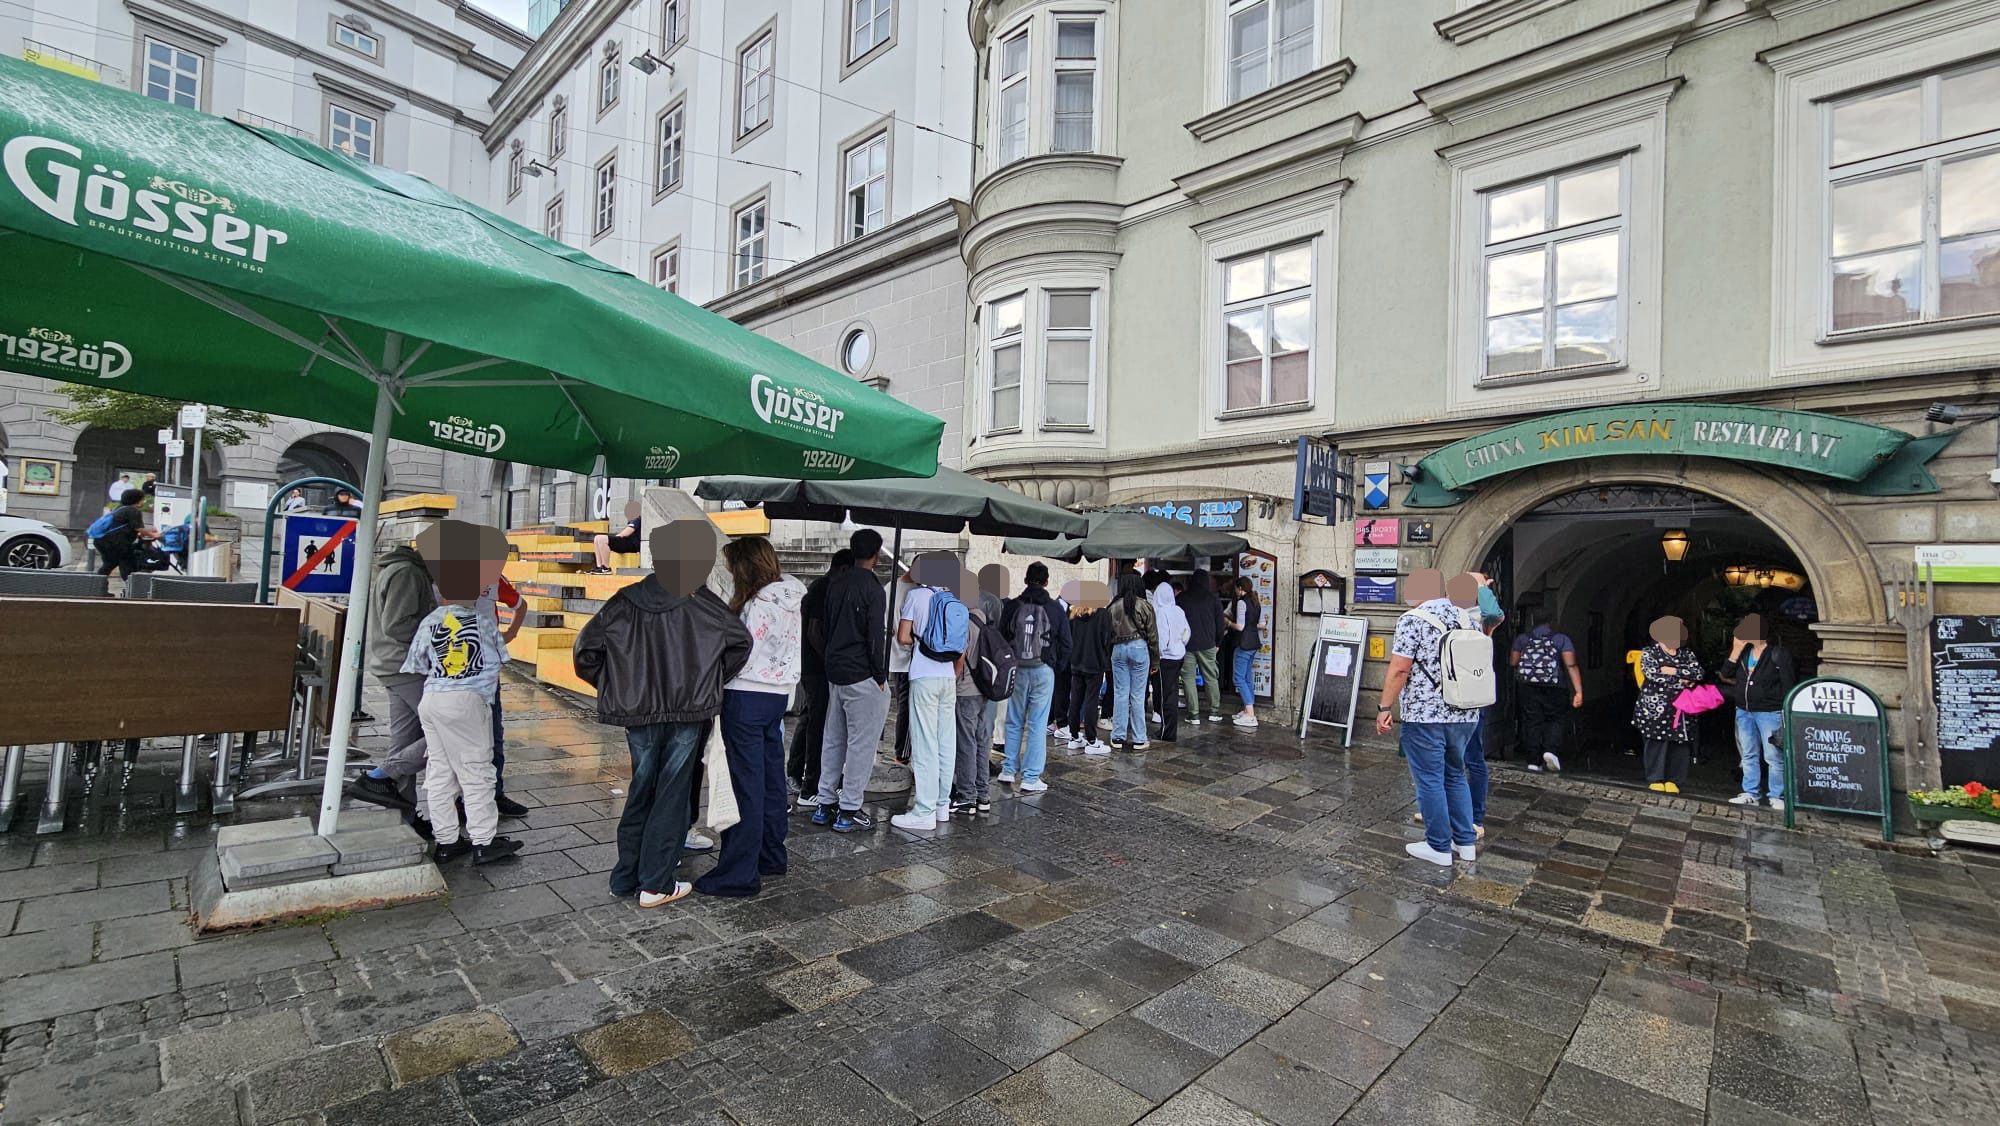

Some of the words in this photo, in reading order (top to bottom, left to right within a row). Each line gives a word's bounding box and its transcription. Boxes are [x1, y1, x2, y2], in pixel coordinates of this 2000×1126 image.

[3, 135, 288, 263] Gösser
[89, 219, 199, 255] BRAUTRADITION
[204, 252, 232, 265] SEIT
[236, 260, 264, 274] 1860
[750, 374, 844, 433] Gösser
[1464, 436, 1526, 469] CHINA
[1537, 422, 1599, 450] KIM
[1603, 418, 1676, 442] SAN
[1693, 420, 1843, 458] RESTAURANT
[1200, 500, 1243, 514] KEBAP
[1414, 524, 1424, 535] 4
[1811, 686, 1855, 700] ALTE
[1812, 700, 1855, 714] WELT
[1804, 727, 1852, 743] SONNTAG
[1833, 743, 1839, 752] &
[1808, 765, 1840, 775] SUNDAYS
